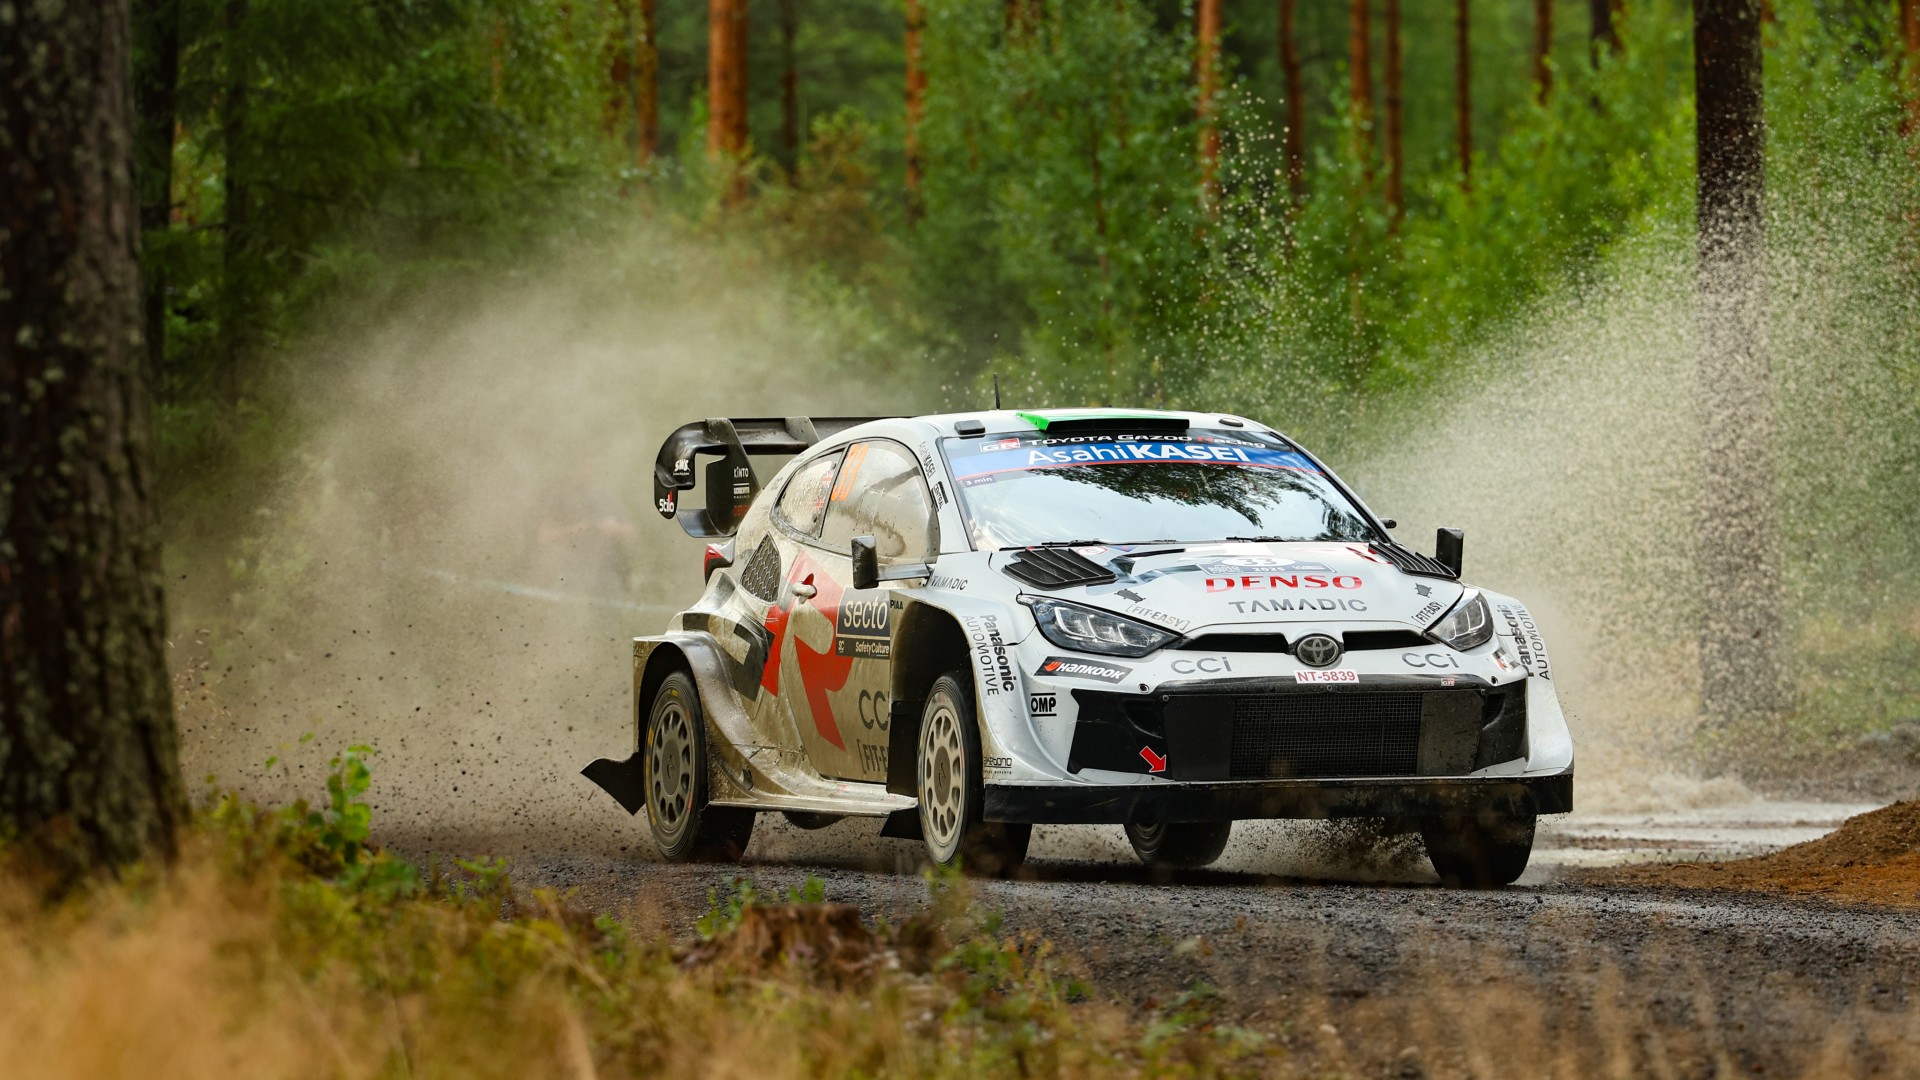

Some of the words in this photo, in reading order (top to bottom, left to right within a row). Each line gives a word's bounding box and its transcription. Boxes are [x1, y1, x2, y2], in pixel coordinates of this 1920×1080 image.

[1027, 435, 1108, 446] TOYOTA
[1117, 434, 1192, 442] GAZOO
[1028, 444, 1251, 466] AsahiKASEI
[659, 490, 675, 512] Stilo
[931, 575, 969, 591] TAMADIC
[1205, 575, 1364, 593] DENSO
[890, 600, 904, 610] PIAA
[1228, 598, 1368, 614] TAMADIC
[843, 597, 889, 631] secto
[855, 641, 890, 656] SafetyCulture
[1509, 603, 1550, 681] AUTOMOTIVE
[962, 615, 1000, 697] AUTOMOTIVE
[979, 614, 1016, 693] Panasonic
[1296, 669, 1357, 684] NT-5839
[1031, 696, 1057, 713] OMP
